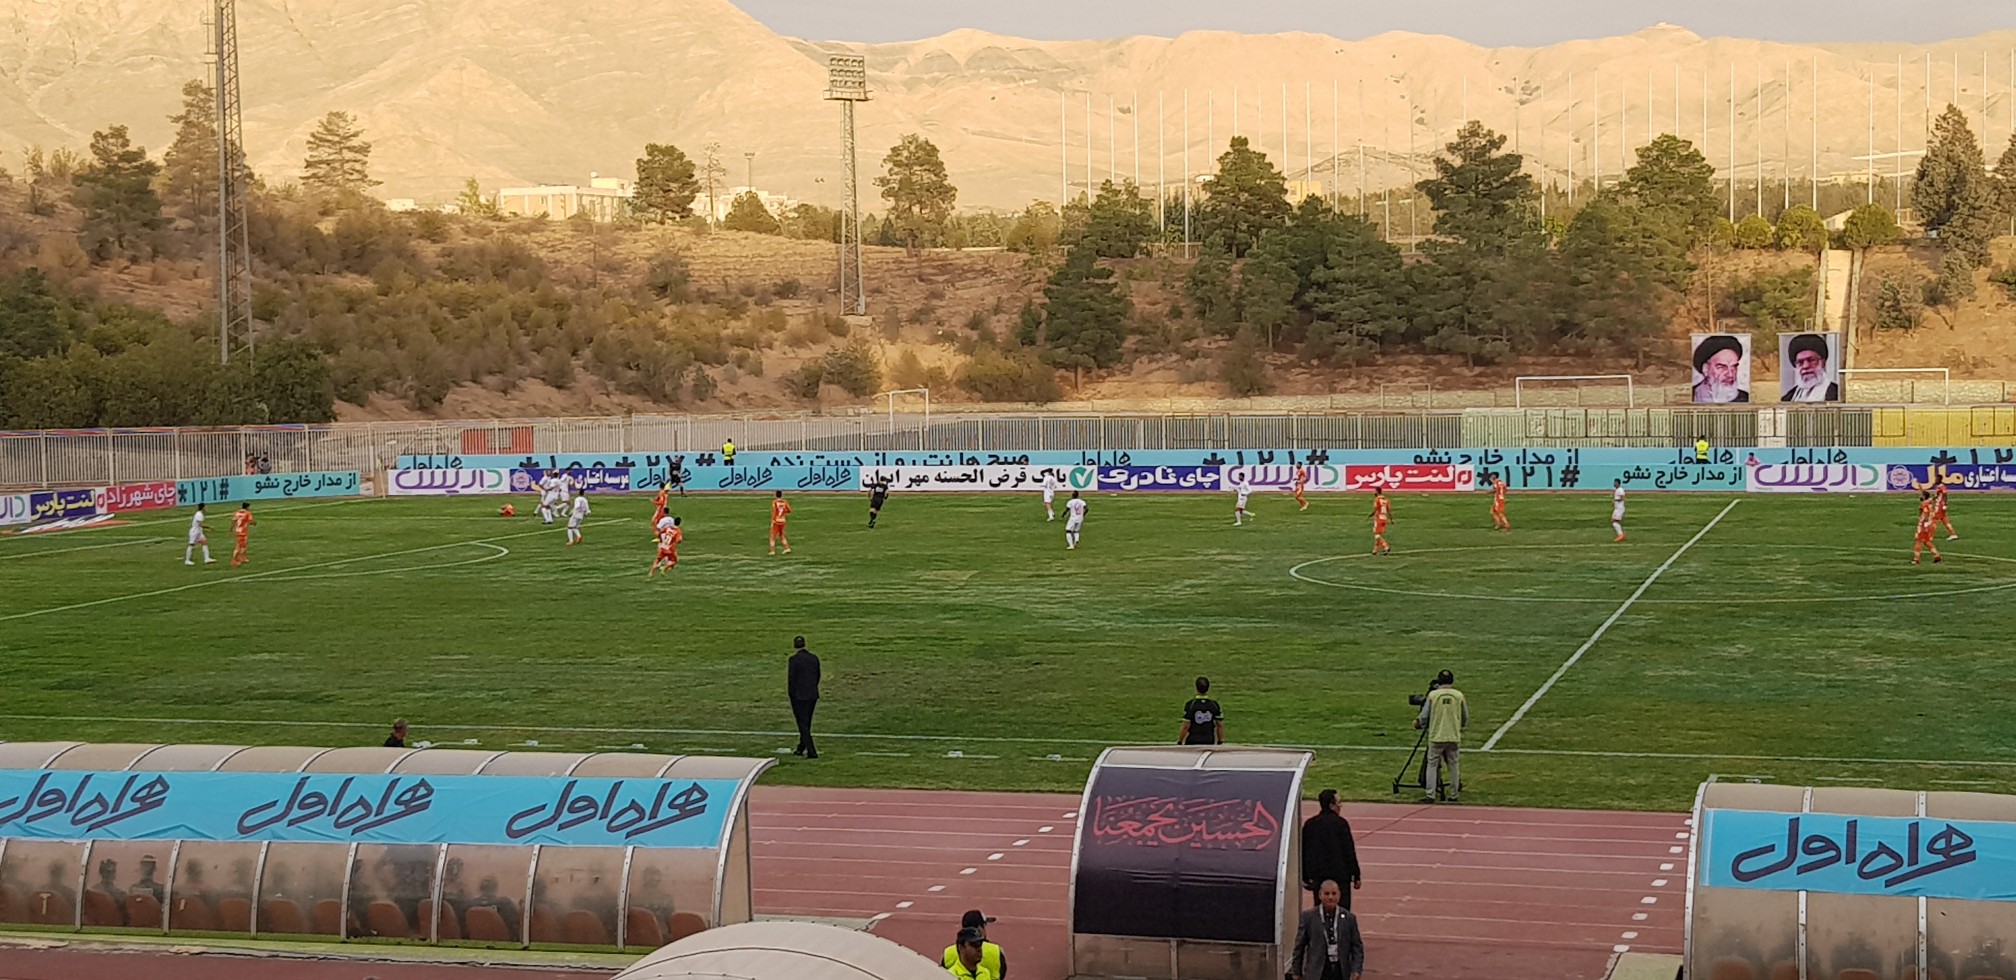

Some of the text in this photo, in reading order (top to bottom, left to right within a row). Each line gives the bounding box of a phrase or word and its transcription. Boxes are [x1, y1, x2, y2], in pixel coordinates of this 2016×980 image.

[255, 473, 356, 496] از مدار خارج نشو
[862, 466, 1066, 488] باک قرض الحسنه مهر ایان
[1098, 466, 1219, 490] چای نادری
[1346, 466, 1455, 489] لنت پارس
[1622, 466, 1742, 488] از مدار خارج نشو
[107, 483, 176, 509] چای شهرزاد
[237, 776, 435, 835] همراه اول
[505, 780, 708, 839] همراه اول
[1731, 817, 1976, 888] همراه اول
